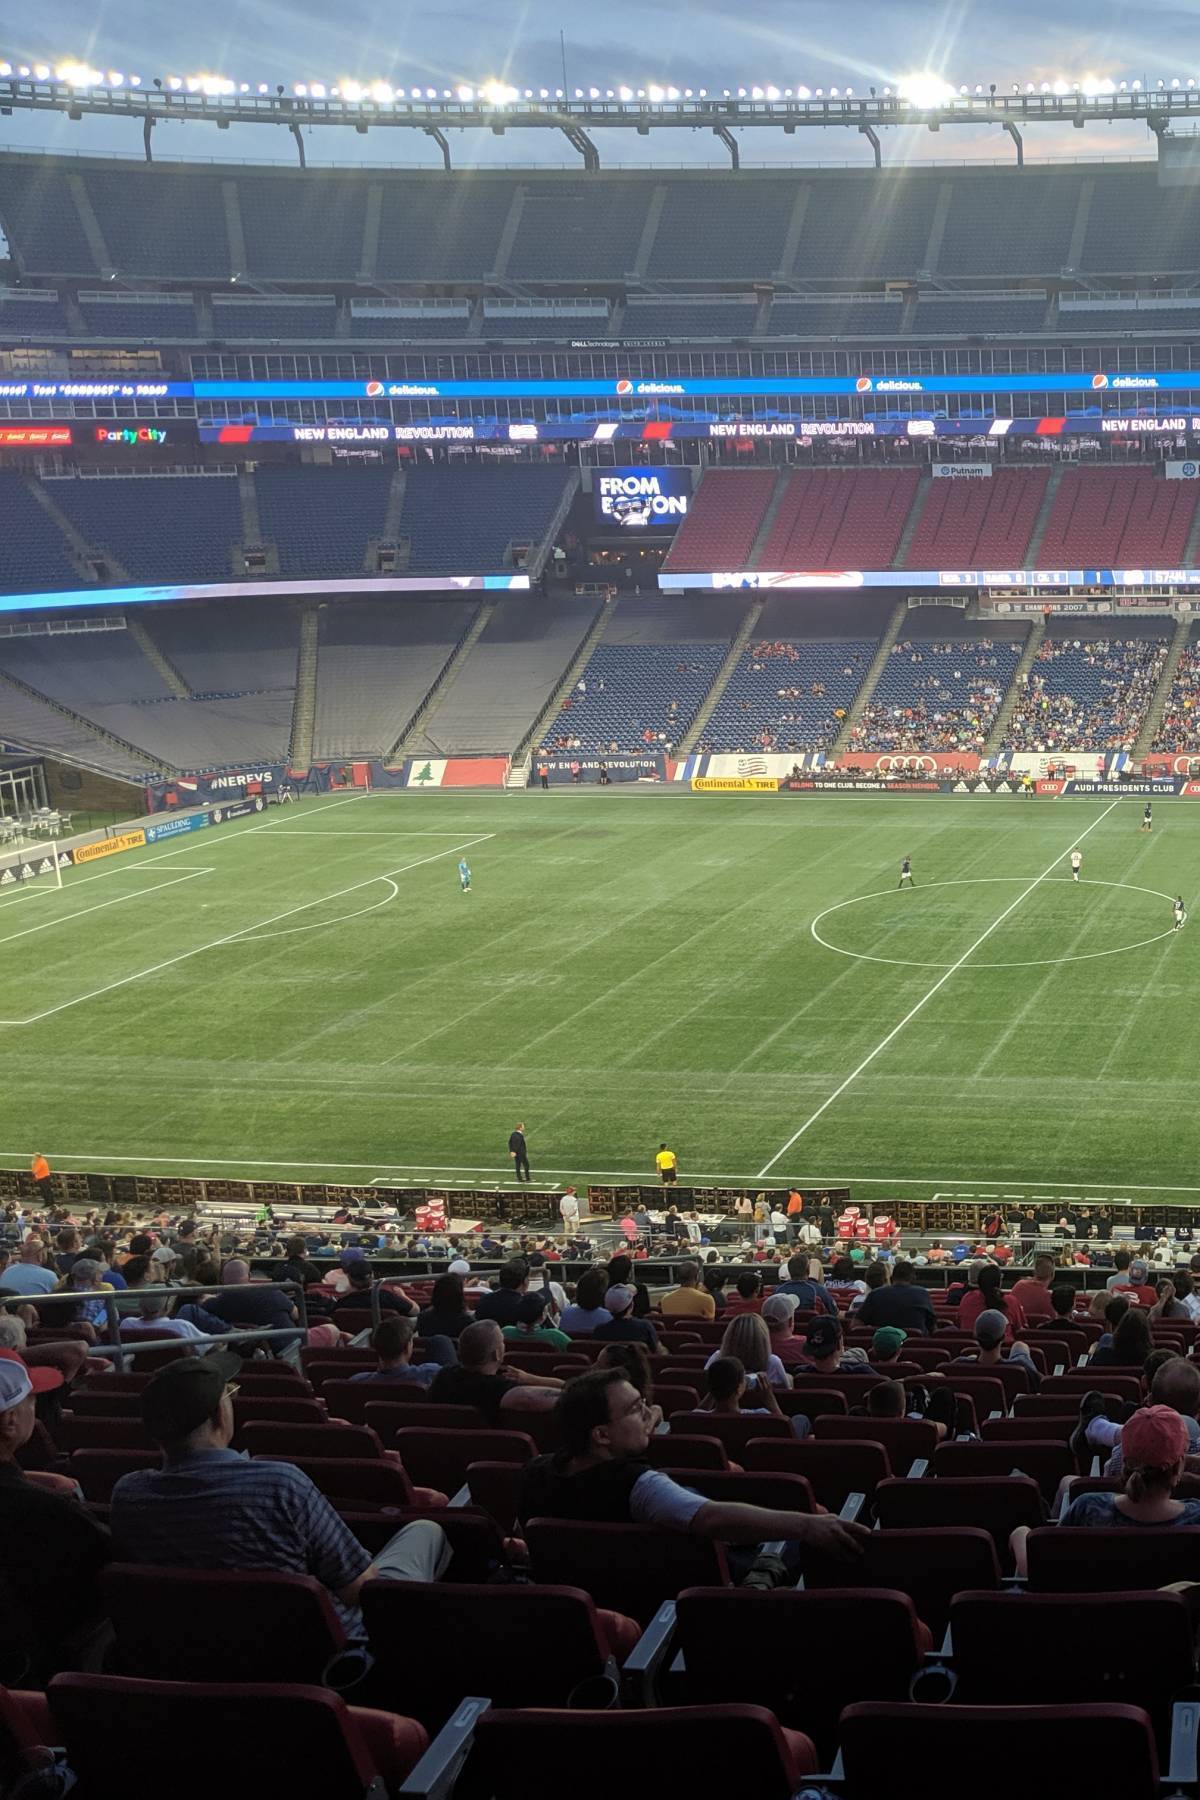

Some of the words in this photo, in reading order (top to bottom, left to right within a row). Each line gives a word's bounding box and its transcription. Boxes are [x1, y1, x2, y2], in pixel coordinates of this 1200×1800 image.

[571, 340, 588, 348] DELL
[877, 381, 922, 390] delicious.
[1113, 377, 1158, 387] delicious.
[389, 385, 440, 395] delicious.
[638, 383, 685, 393] delicious.
[710, 425, 736, 436] NEW
[740, 424, 795, 435] ENGLAND
[801, 423, 874, 435] REVOLUTION
[1102, 420, 1128, 431] NEW
[1131, 418, 1186, 430] ENGLAND
[294, 428, 324, 440] NEW
[328, 428, 388, 439] ENGLAND
[396, 427, 474, 439] REVOLUTION
[951, 466, 983, 475] Putnam
[600, 477, 660, 495] FROM
[211, 772, 272, 790] #NEREVS
[694, 778, 745, 789] Continental
[756, 781, 775, 789] TIRE
[1074, 784, 1095, 793] AUDI
[1097, 784, 1150, 793] PRESIDENTS
[1153, 784, 1174, 793] CLUB
[156, 818, 191, 833] SPAULDING
[76, 838, 119, 861] Continental
[126, 834, 143, 845] TIRE
